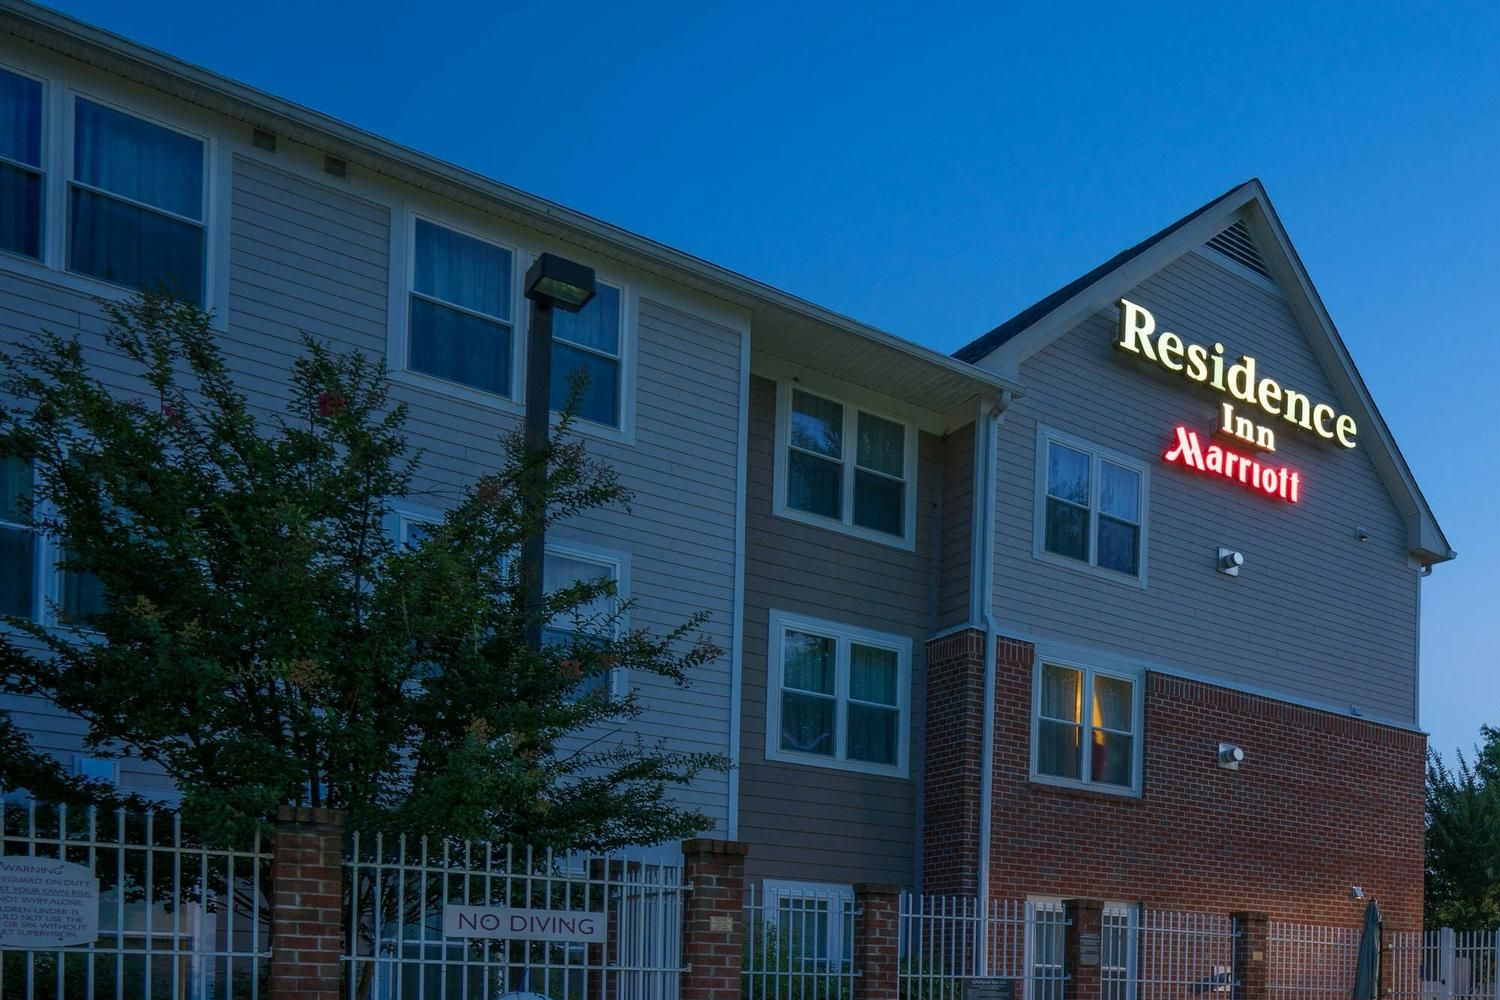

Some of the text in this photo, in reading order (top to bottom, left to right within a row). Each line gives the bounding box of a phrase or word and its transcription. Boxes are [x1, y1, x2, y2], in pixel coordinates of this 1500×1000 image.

[1119, 298, 1358, 448] Residence
[1221, 402, 1276, 452] Inn
[1164, 426, 1301, 503] Marriott
[3, 864, 63, 875] WARNING
[0, 876, 42, 885] EGUARD
[14, 886, 40, 894] YOUR
[43, 888, 69, 896] OWN
[21, 896, 48, 905] SWIM
[0, 906, 31, 914] LDREN
[34, 908, 67, 916] UNDER
[21, 913, 42, 922] NOT
[65, 916, 84, 924] THE
[458, 912, 595, 935] NO DIVING
[3, 920, 87, 931] OR SPA WITHOUT
